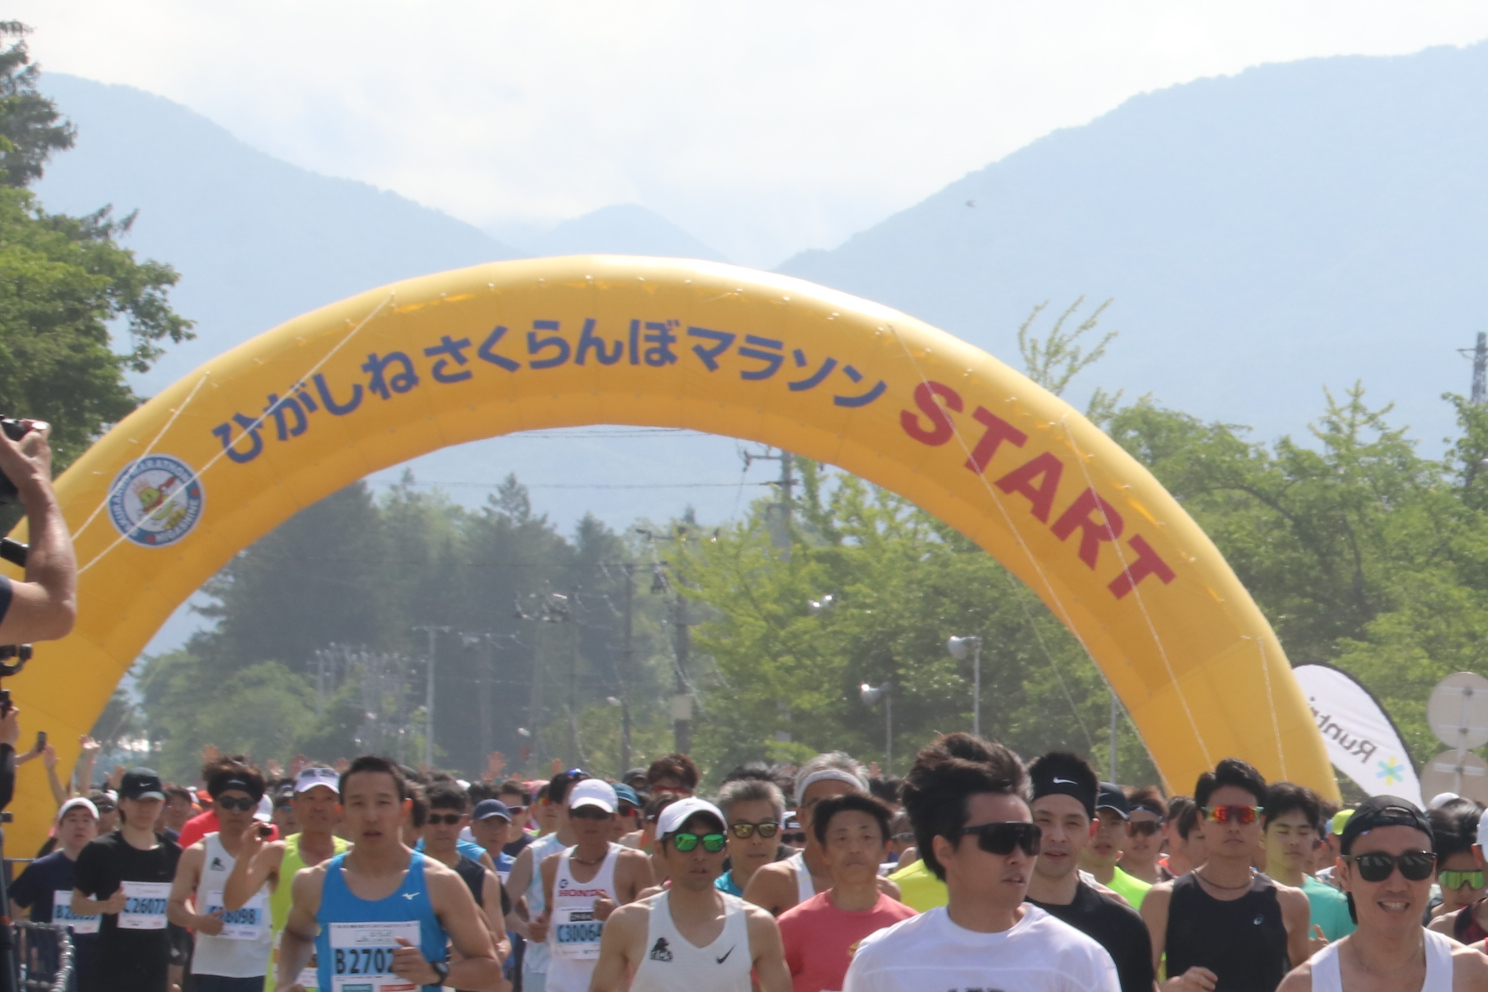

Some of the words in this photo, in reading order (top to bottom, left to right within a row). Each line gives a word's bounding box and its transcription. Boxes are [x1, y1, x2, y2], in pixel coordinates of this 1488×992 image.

[212, 317, 887, 464] ひがしねさくらんぼマラソン
[900, 380, 1176, 600] START
[335, 949, 394, 974] B2702
